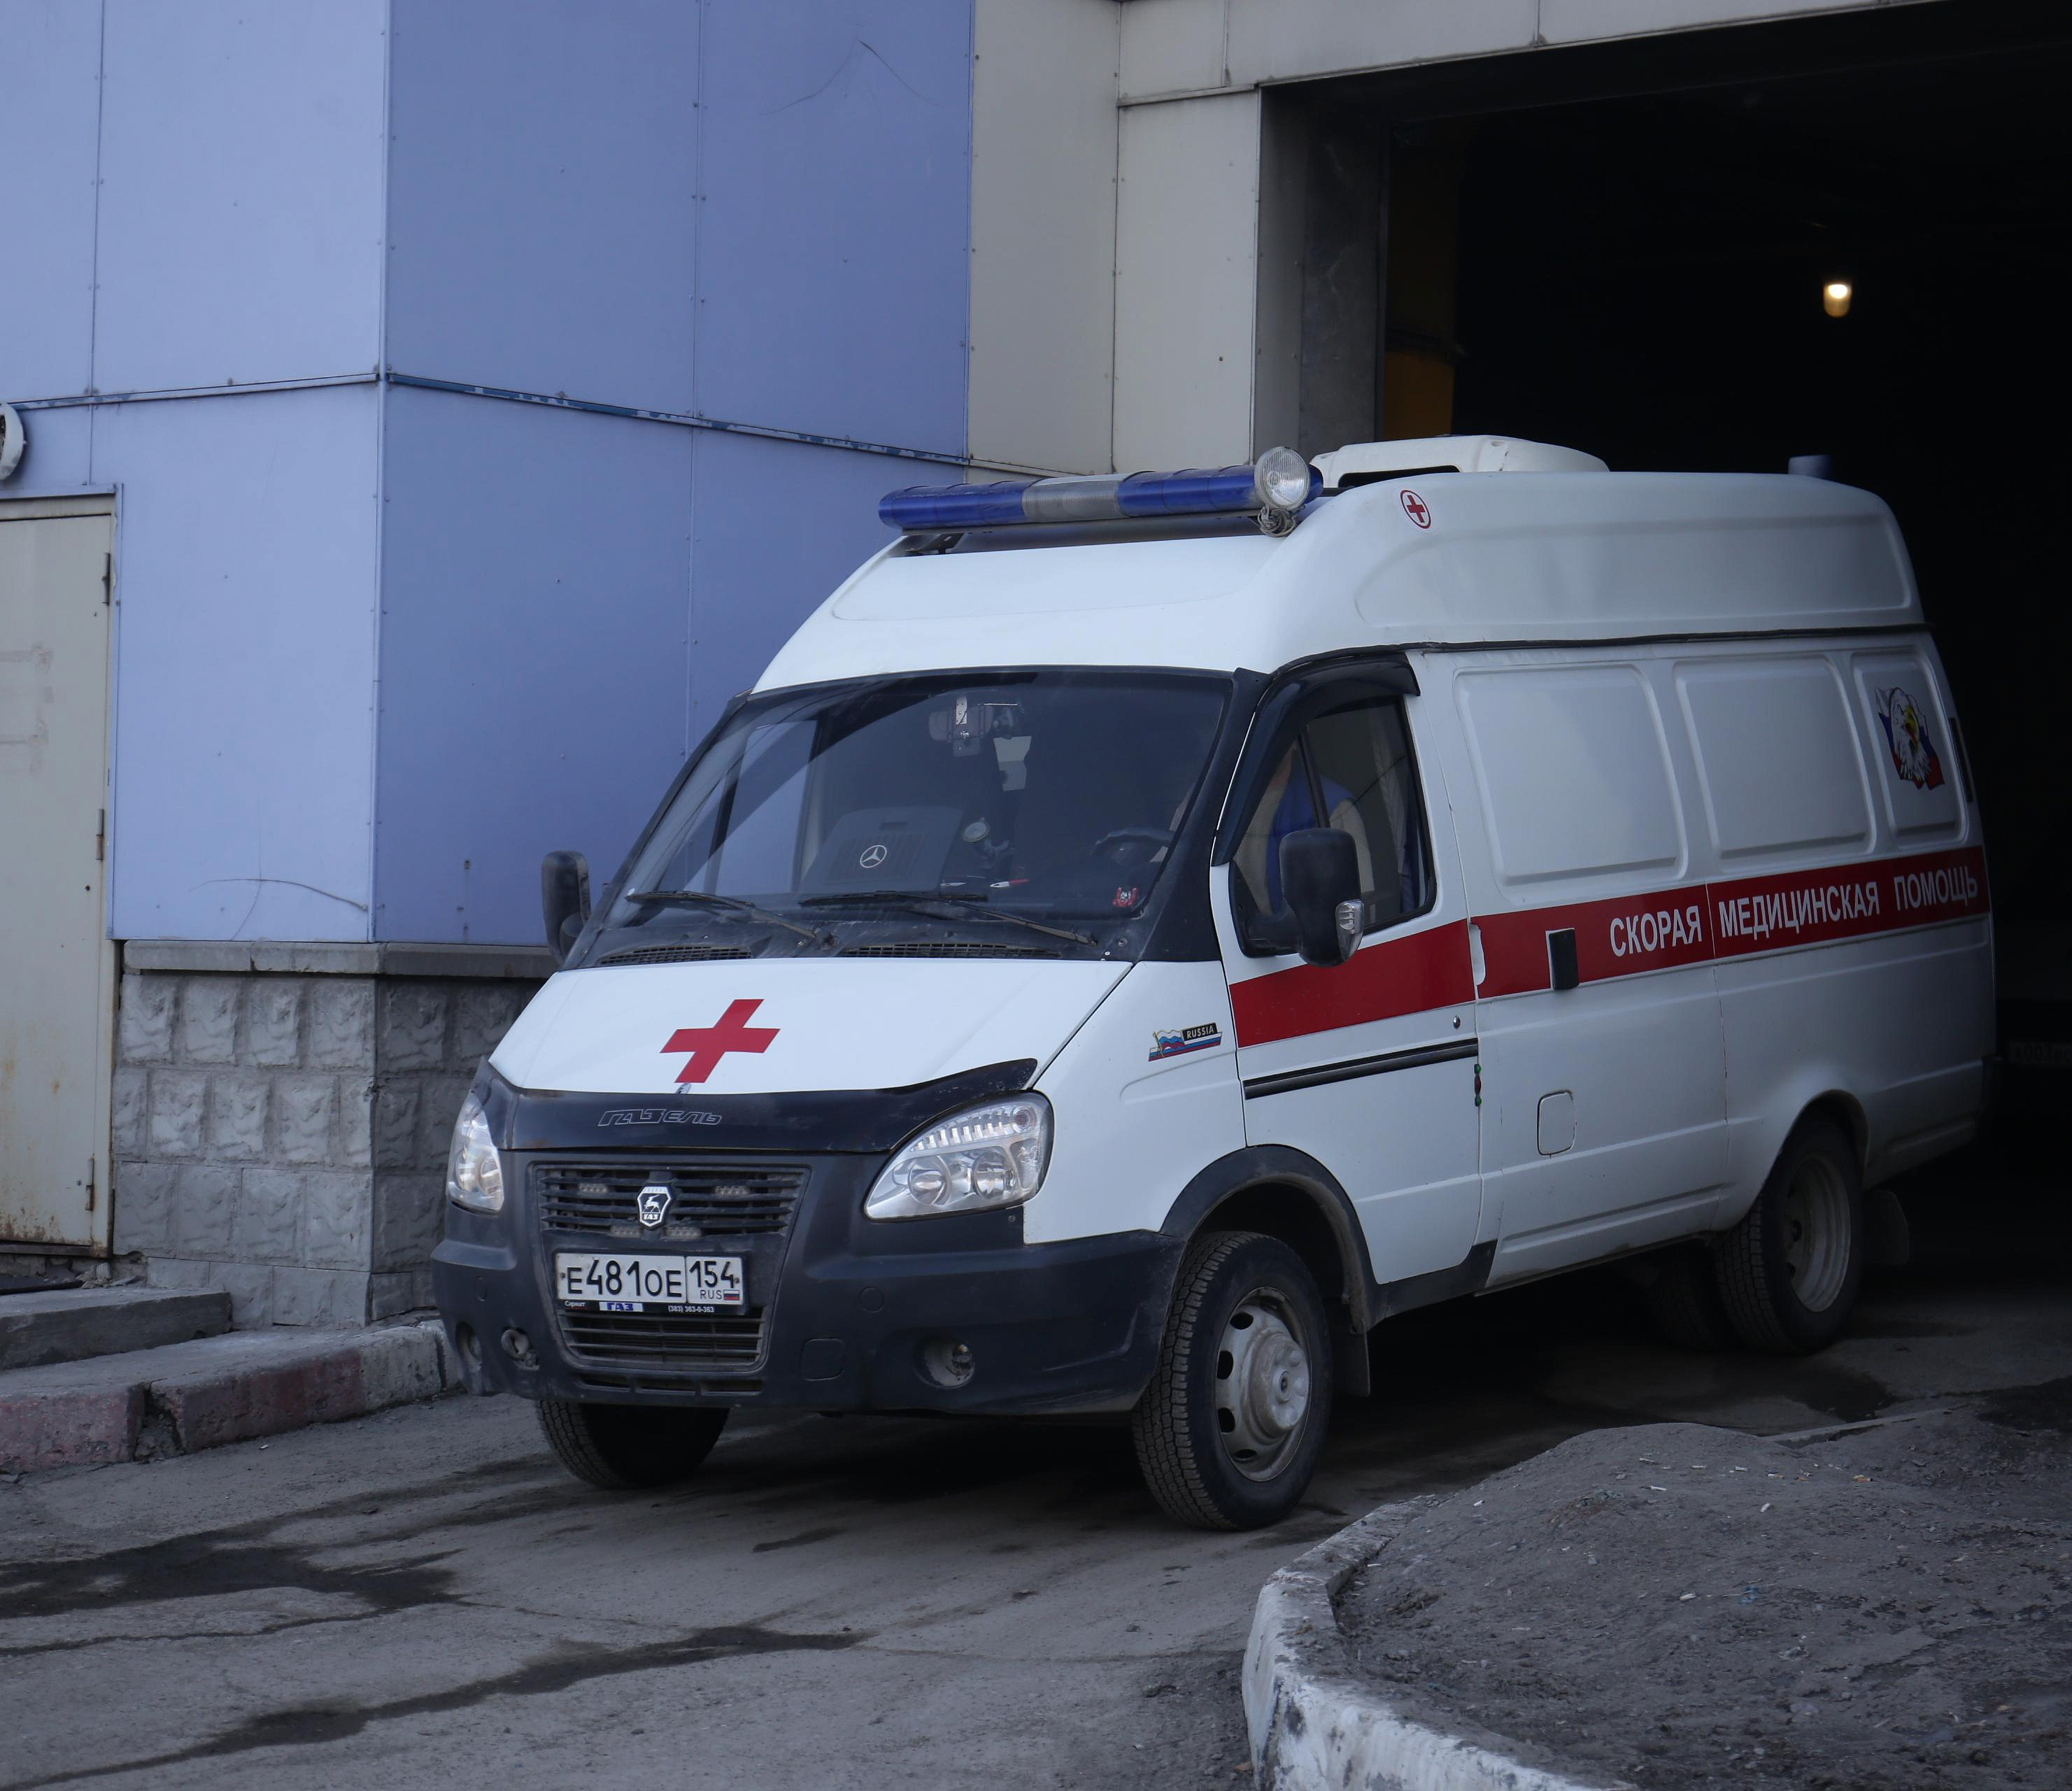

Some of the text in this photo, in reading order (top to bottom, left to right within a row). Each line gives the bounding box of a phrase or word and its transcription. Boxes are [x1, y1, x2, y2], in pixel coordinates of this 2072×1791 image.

[1610, 865, 1978, 957] СКОРАЯ МЕДИЦИНСКАЯ ПОМОЩЬ
[1186, 1025, 1214, 1040] RUSSIA
[689, 1260, 735, 1289] 154
[700, 1290, 723, 1300] RUS
[606, 1303, 634, 1311] ГАЗ
